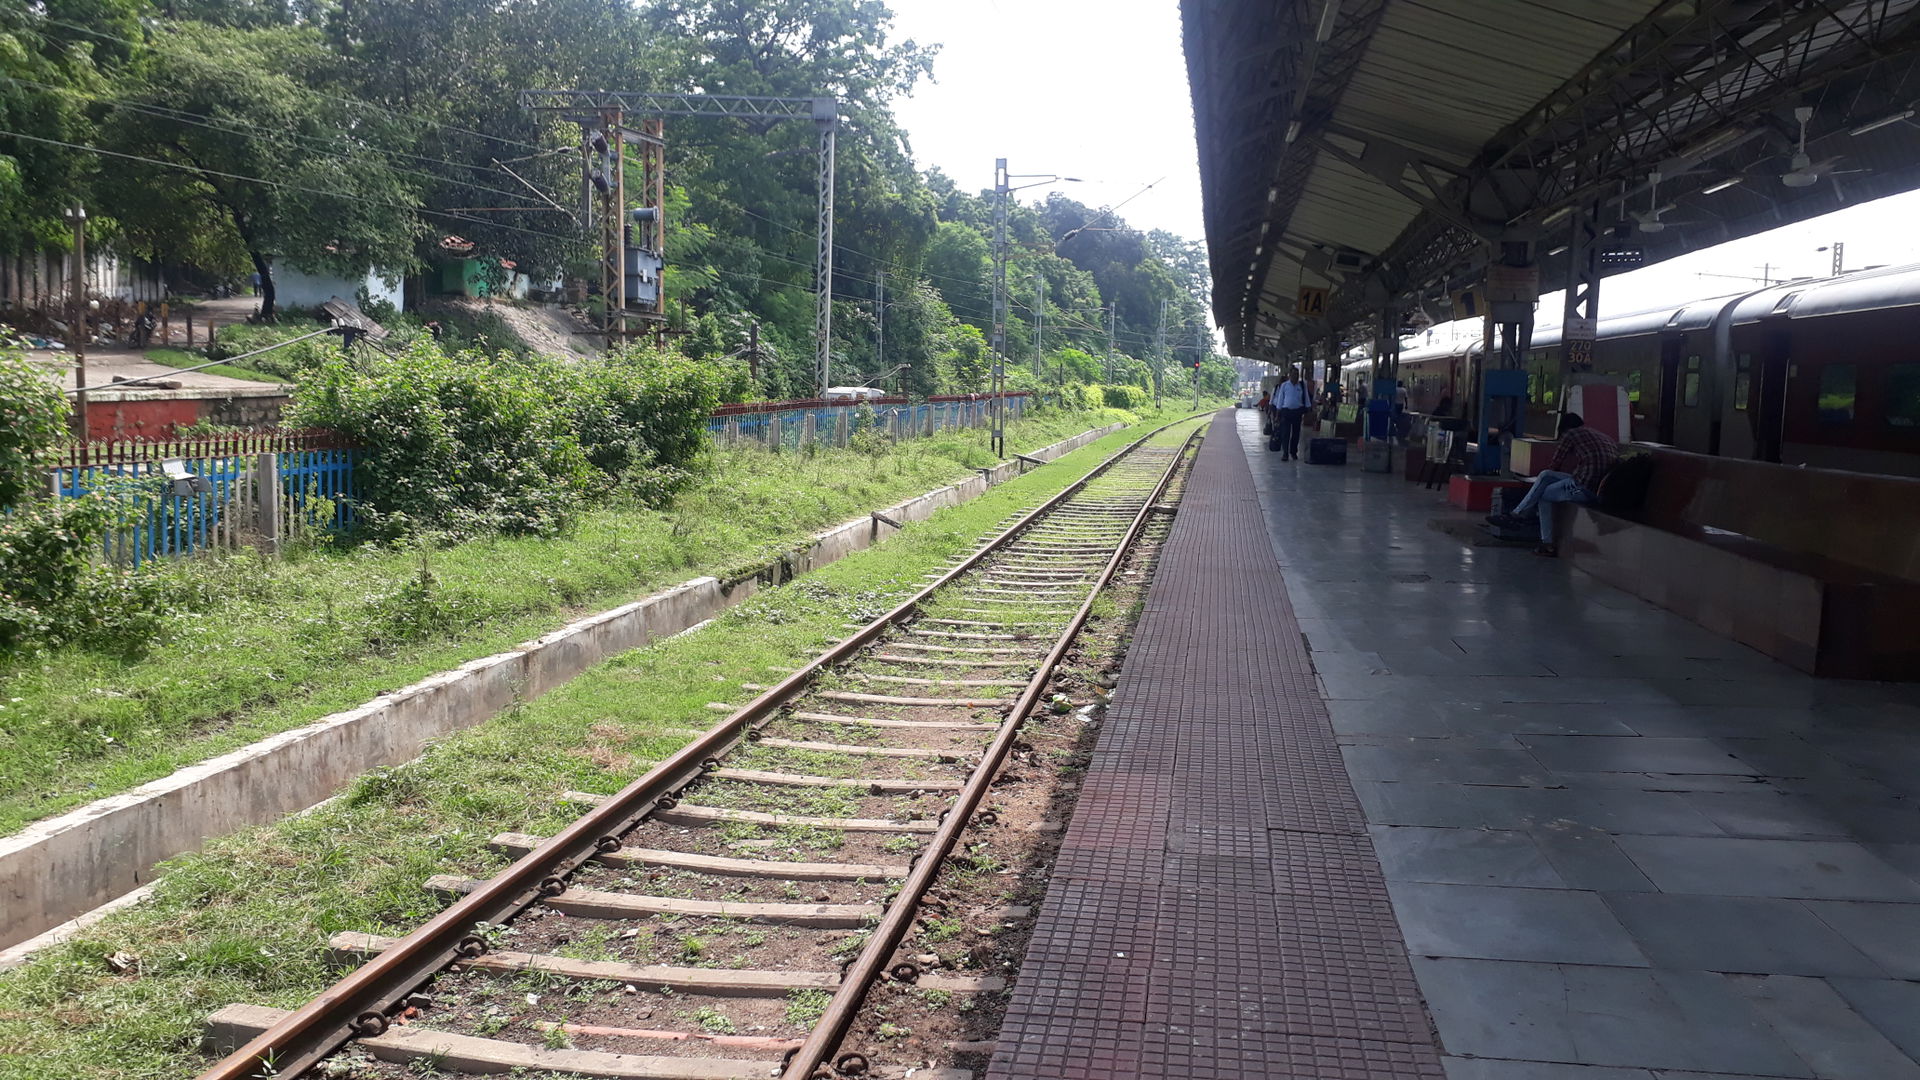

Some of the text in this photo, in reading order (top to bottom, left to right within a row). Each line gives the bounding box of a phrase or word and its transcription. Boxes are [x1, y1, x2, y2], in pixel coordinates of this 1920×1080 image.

[1303, 292, 1321, 312] 1A
[1460, 292, 1476, 315] 1
[1568, 353, 1592, 364] 30A
